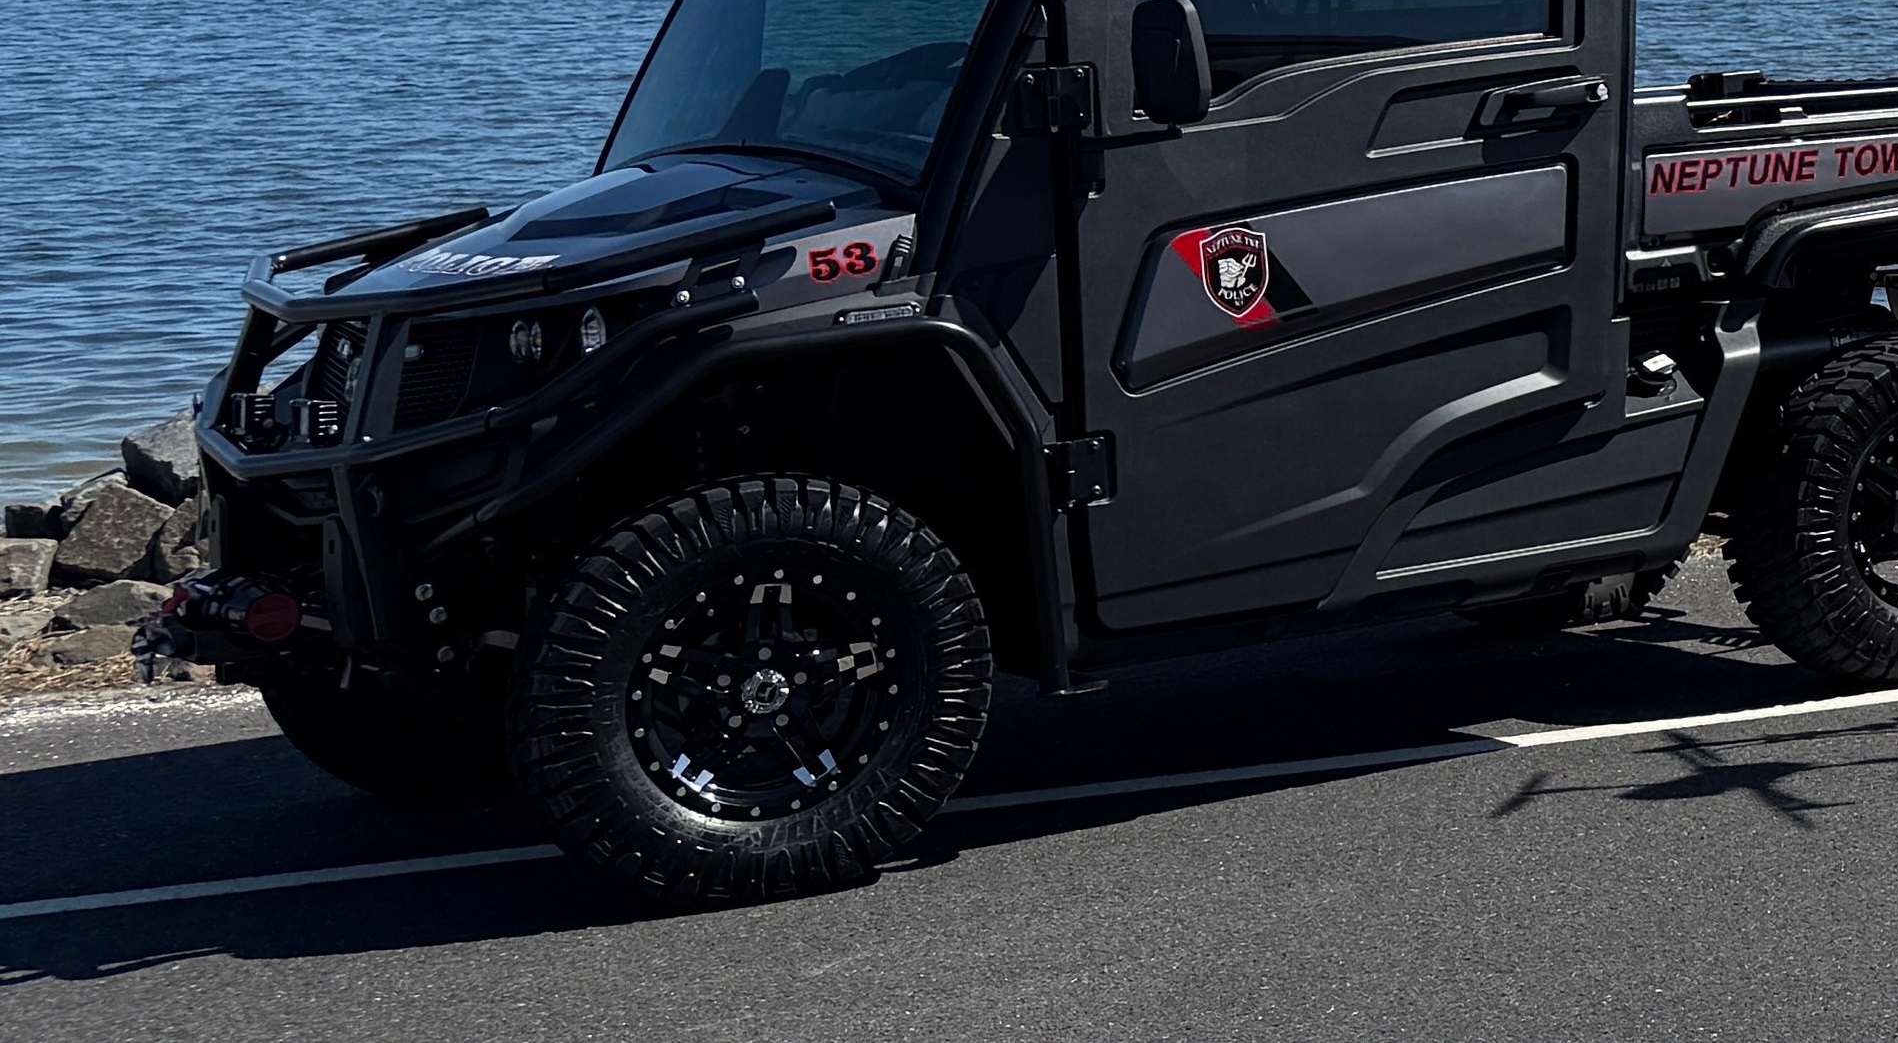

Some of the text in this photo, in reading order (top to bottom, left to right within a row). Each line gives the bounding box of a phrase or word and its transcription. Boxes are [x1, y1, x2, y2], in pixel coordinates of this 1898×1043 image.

[1649, 150, 1820, 196] NEPTUNE
[808, 241, 881, 285] 53
[1218, 283, 1259, 300] POLICE
